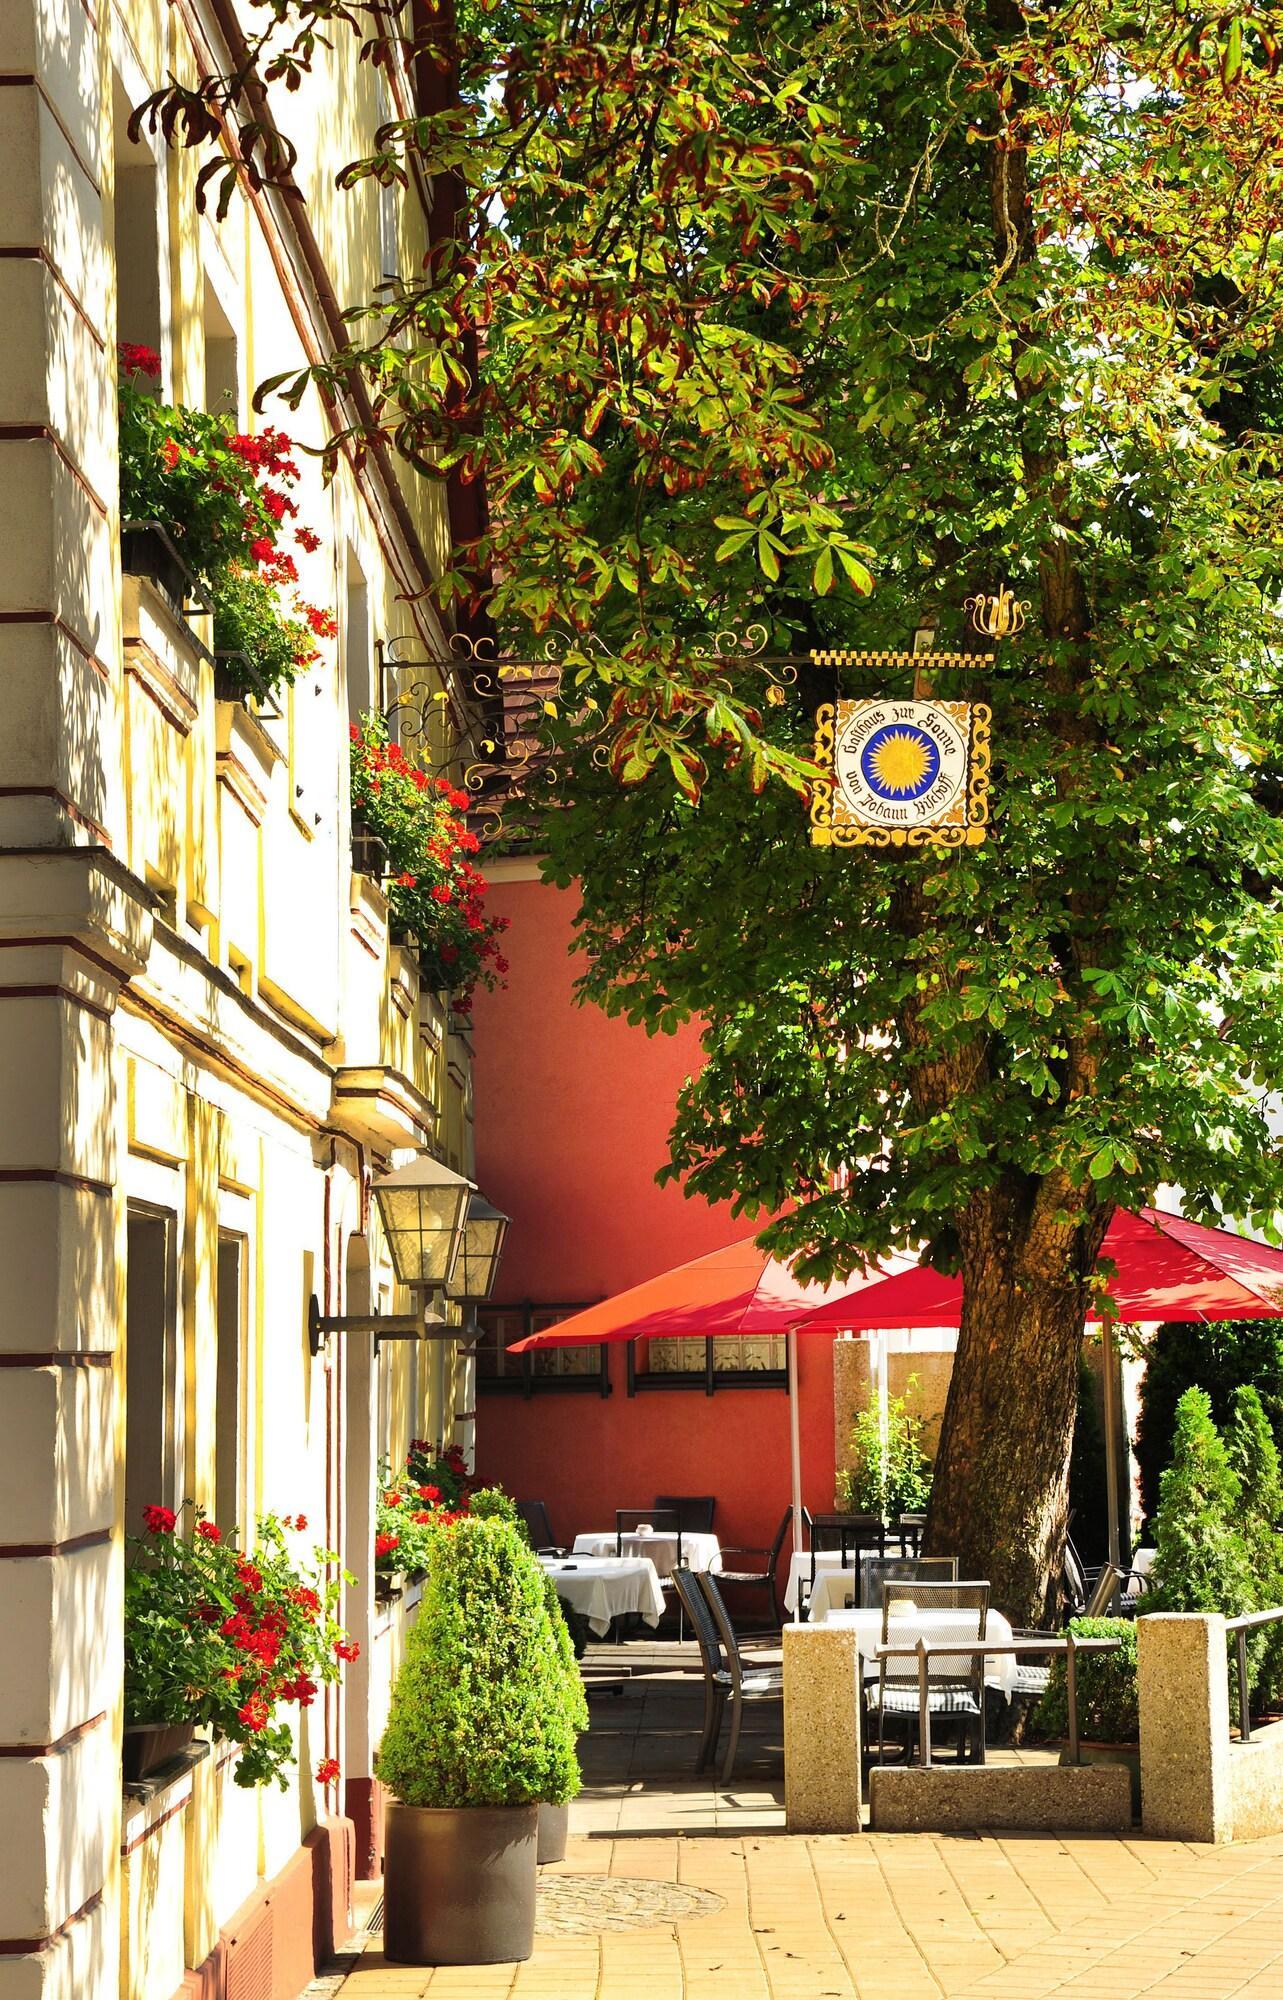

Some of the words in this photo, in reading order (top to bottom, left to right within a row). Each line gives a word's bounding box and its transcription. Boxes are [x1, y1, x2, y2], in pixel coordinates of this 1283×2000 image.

[892, 707, 915, 722] zur
[917, 712, 956, 756] Sonne
[847, 770, 863, 796] von
[858, 793, 908, 820] Johann
